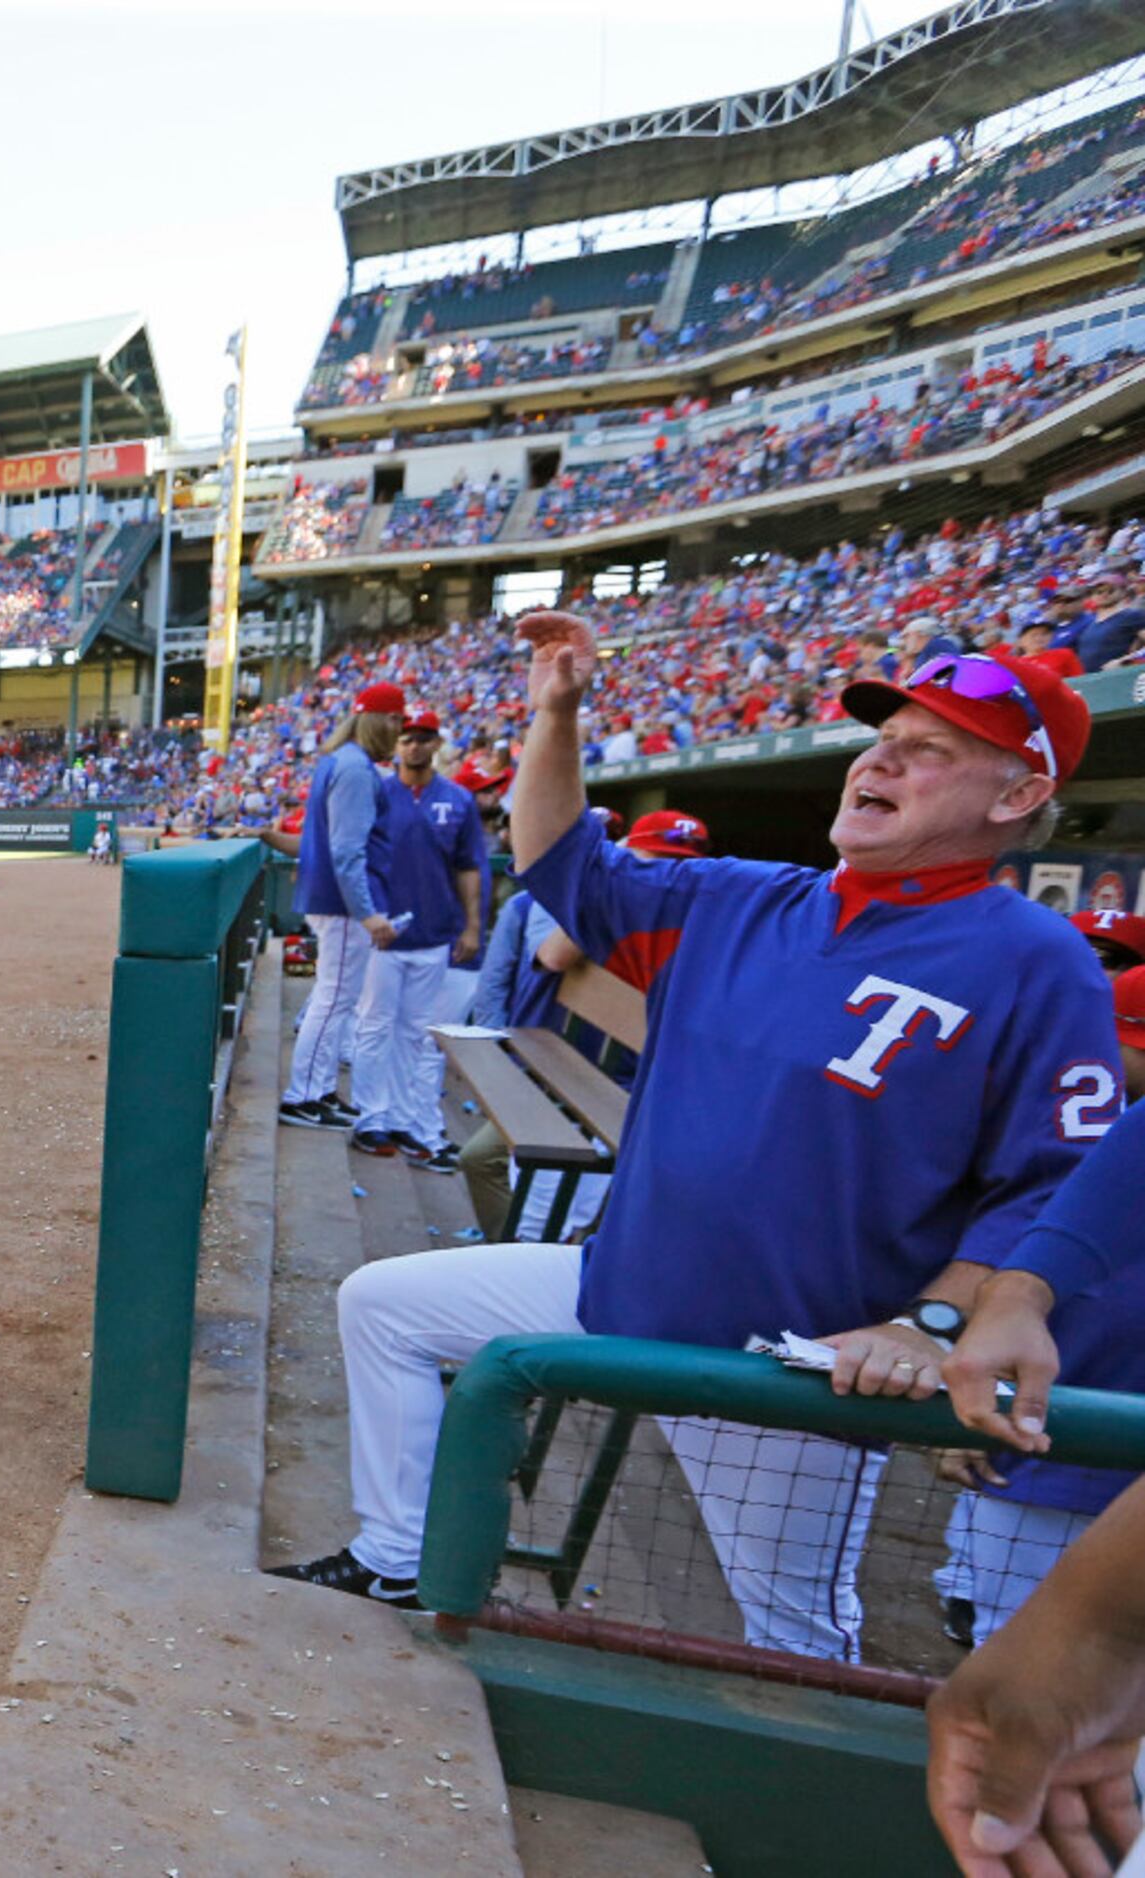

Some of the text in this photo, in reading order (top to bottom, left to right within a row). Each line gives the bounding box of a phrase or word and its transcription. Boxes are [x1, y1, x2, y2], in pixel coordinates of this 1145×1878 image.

[12, 460, 57, 485] CAP
[430, 802, 453, 824] T
[674, 819, 698, 837] T
[1094, 909, 1127, 929] T
[824, 973, 974, 1100] T
